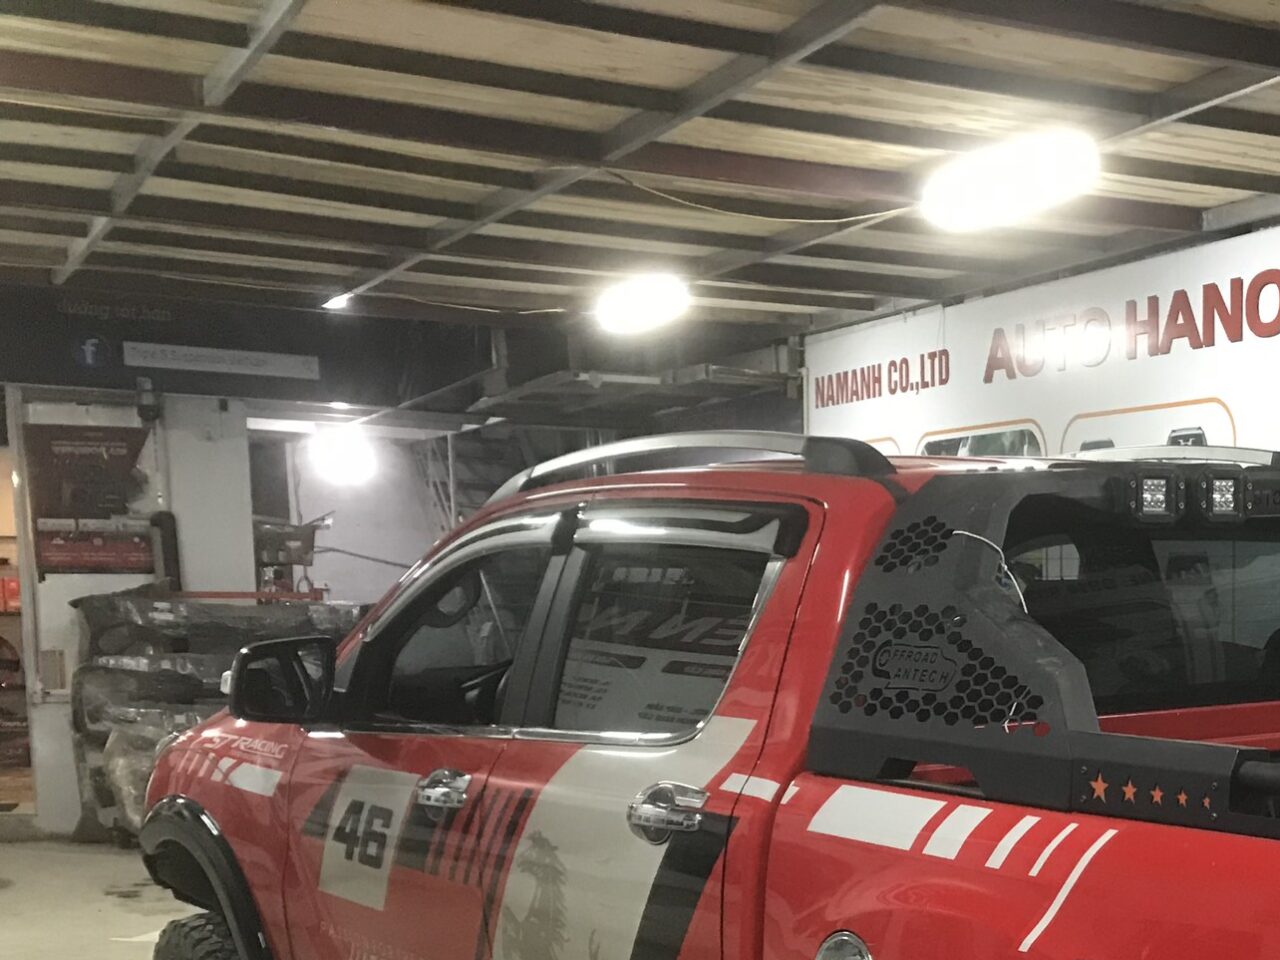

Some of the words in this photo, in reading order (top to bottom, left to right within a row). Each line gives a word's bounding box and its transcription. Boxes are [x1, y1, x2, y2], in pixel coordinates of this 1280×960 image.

[983, 306, 1112, 383] AUTO
[815, 363, 882, 409] NAMANH
[887, 348, 950, 396] CO.,LTD
[231, 737, 289, 759] RACING
[332, 799, 393, 870] 46
